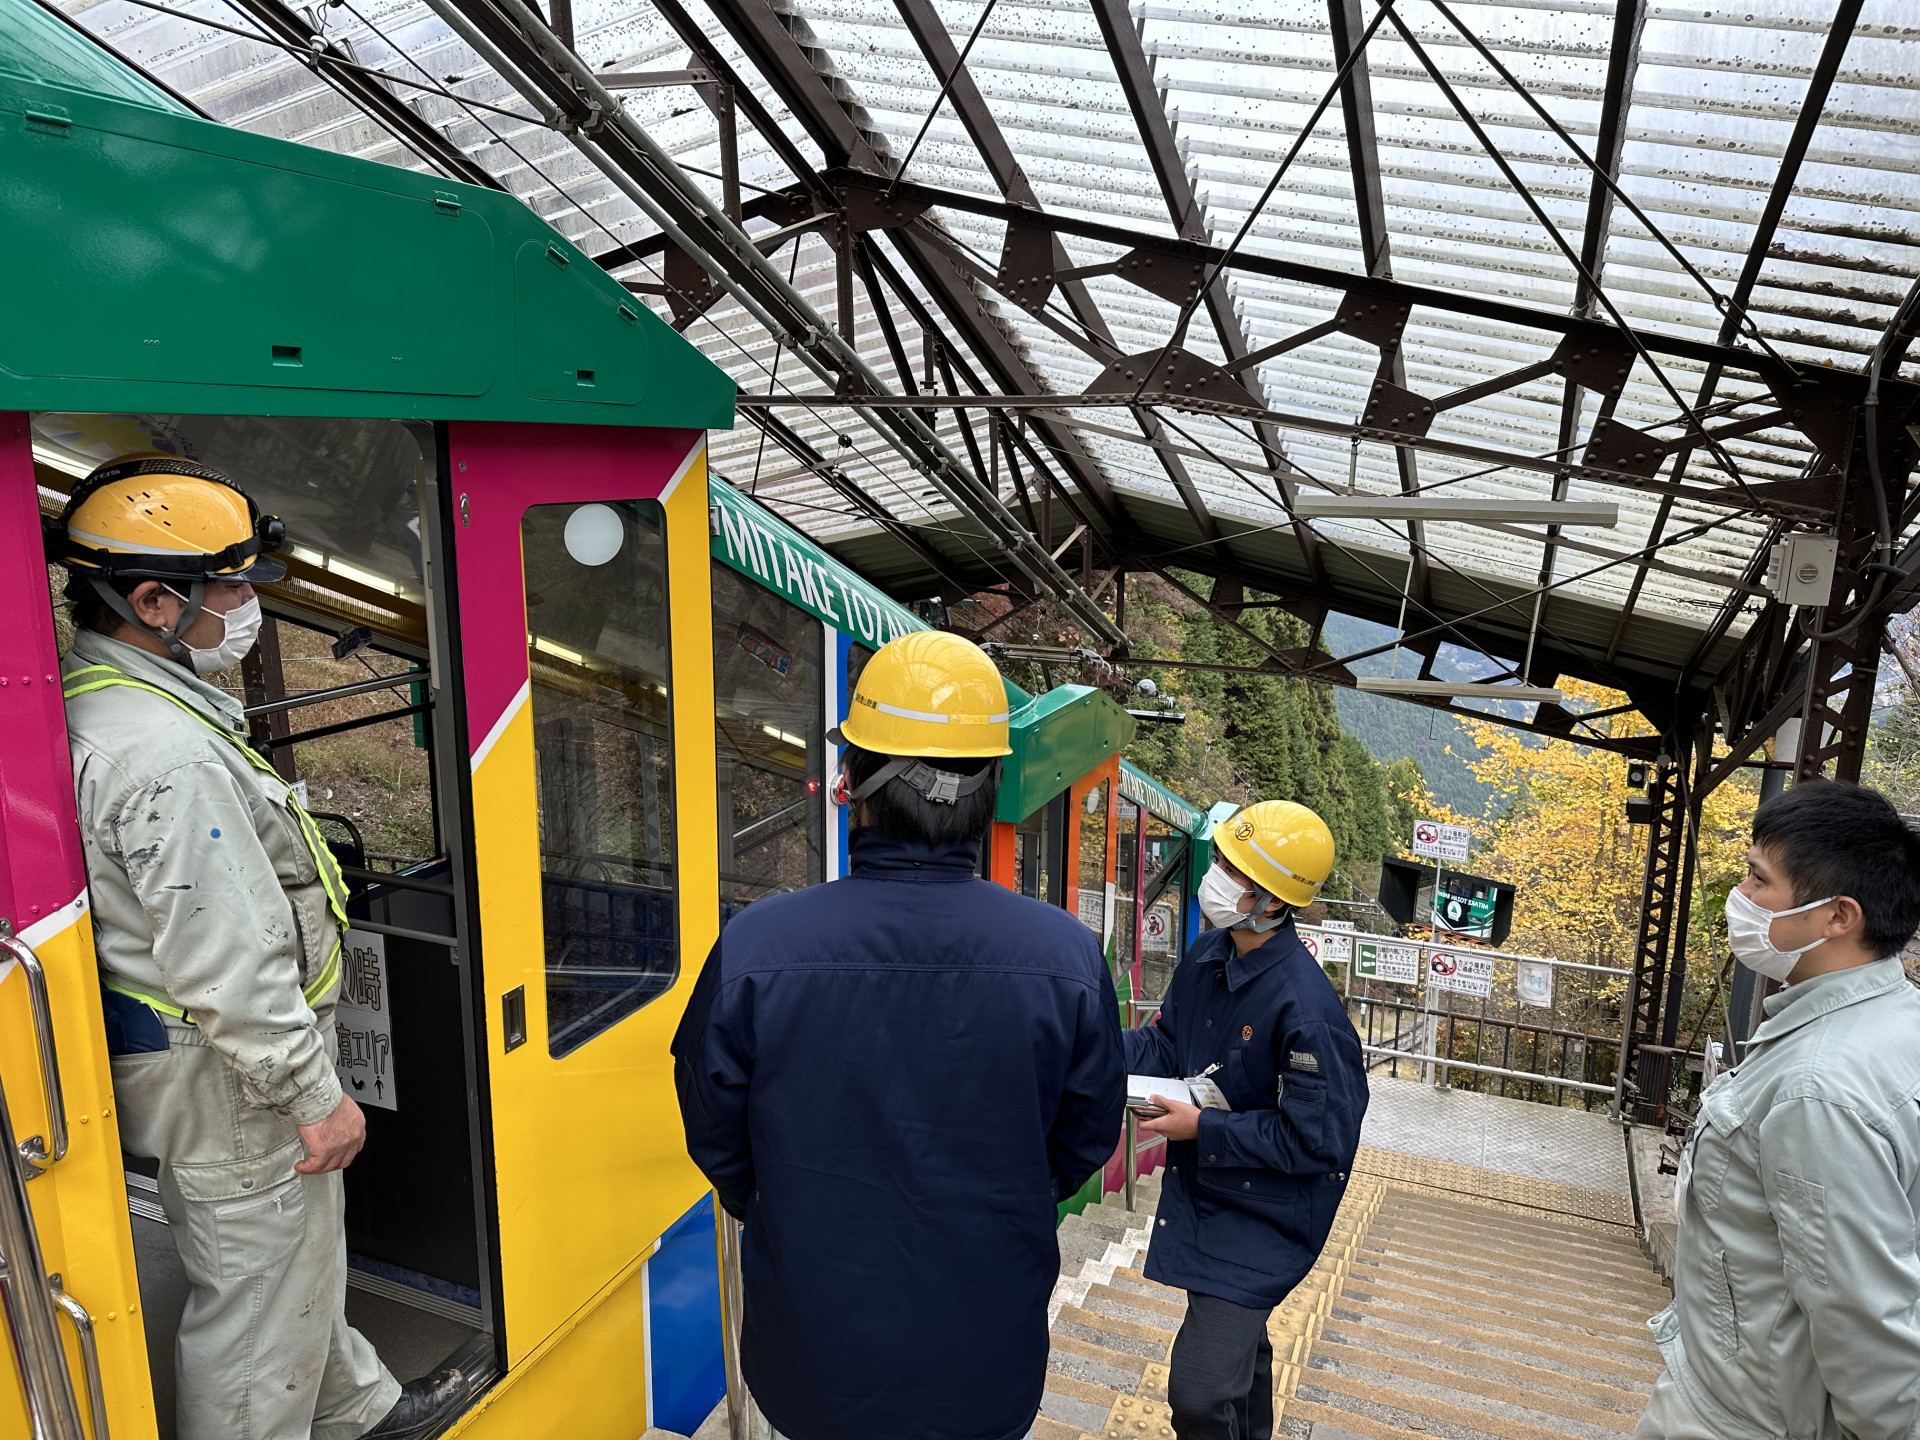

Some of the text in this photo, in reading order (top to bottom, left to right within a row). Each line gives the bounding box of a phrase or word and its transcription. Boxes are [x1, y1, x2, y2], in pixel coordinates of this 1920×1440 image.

[714, 496, 840, 622] MITAKE
[1458, 960, 1491, 971] カメラ撮影は
[336, 1022, 389, 1075] 有エリア
